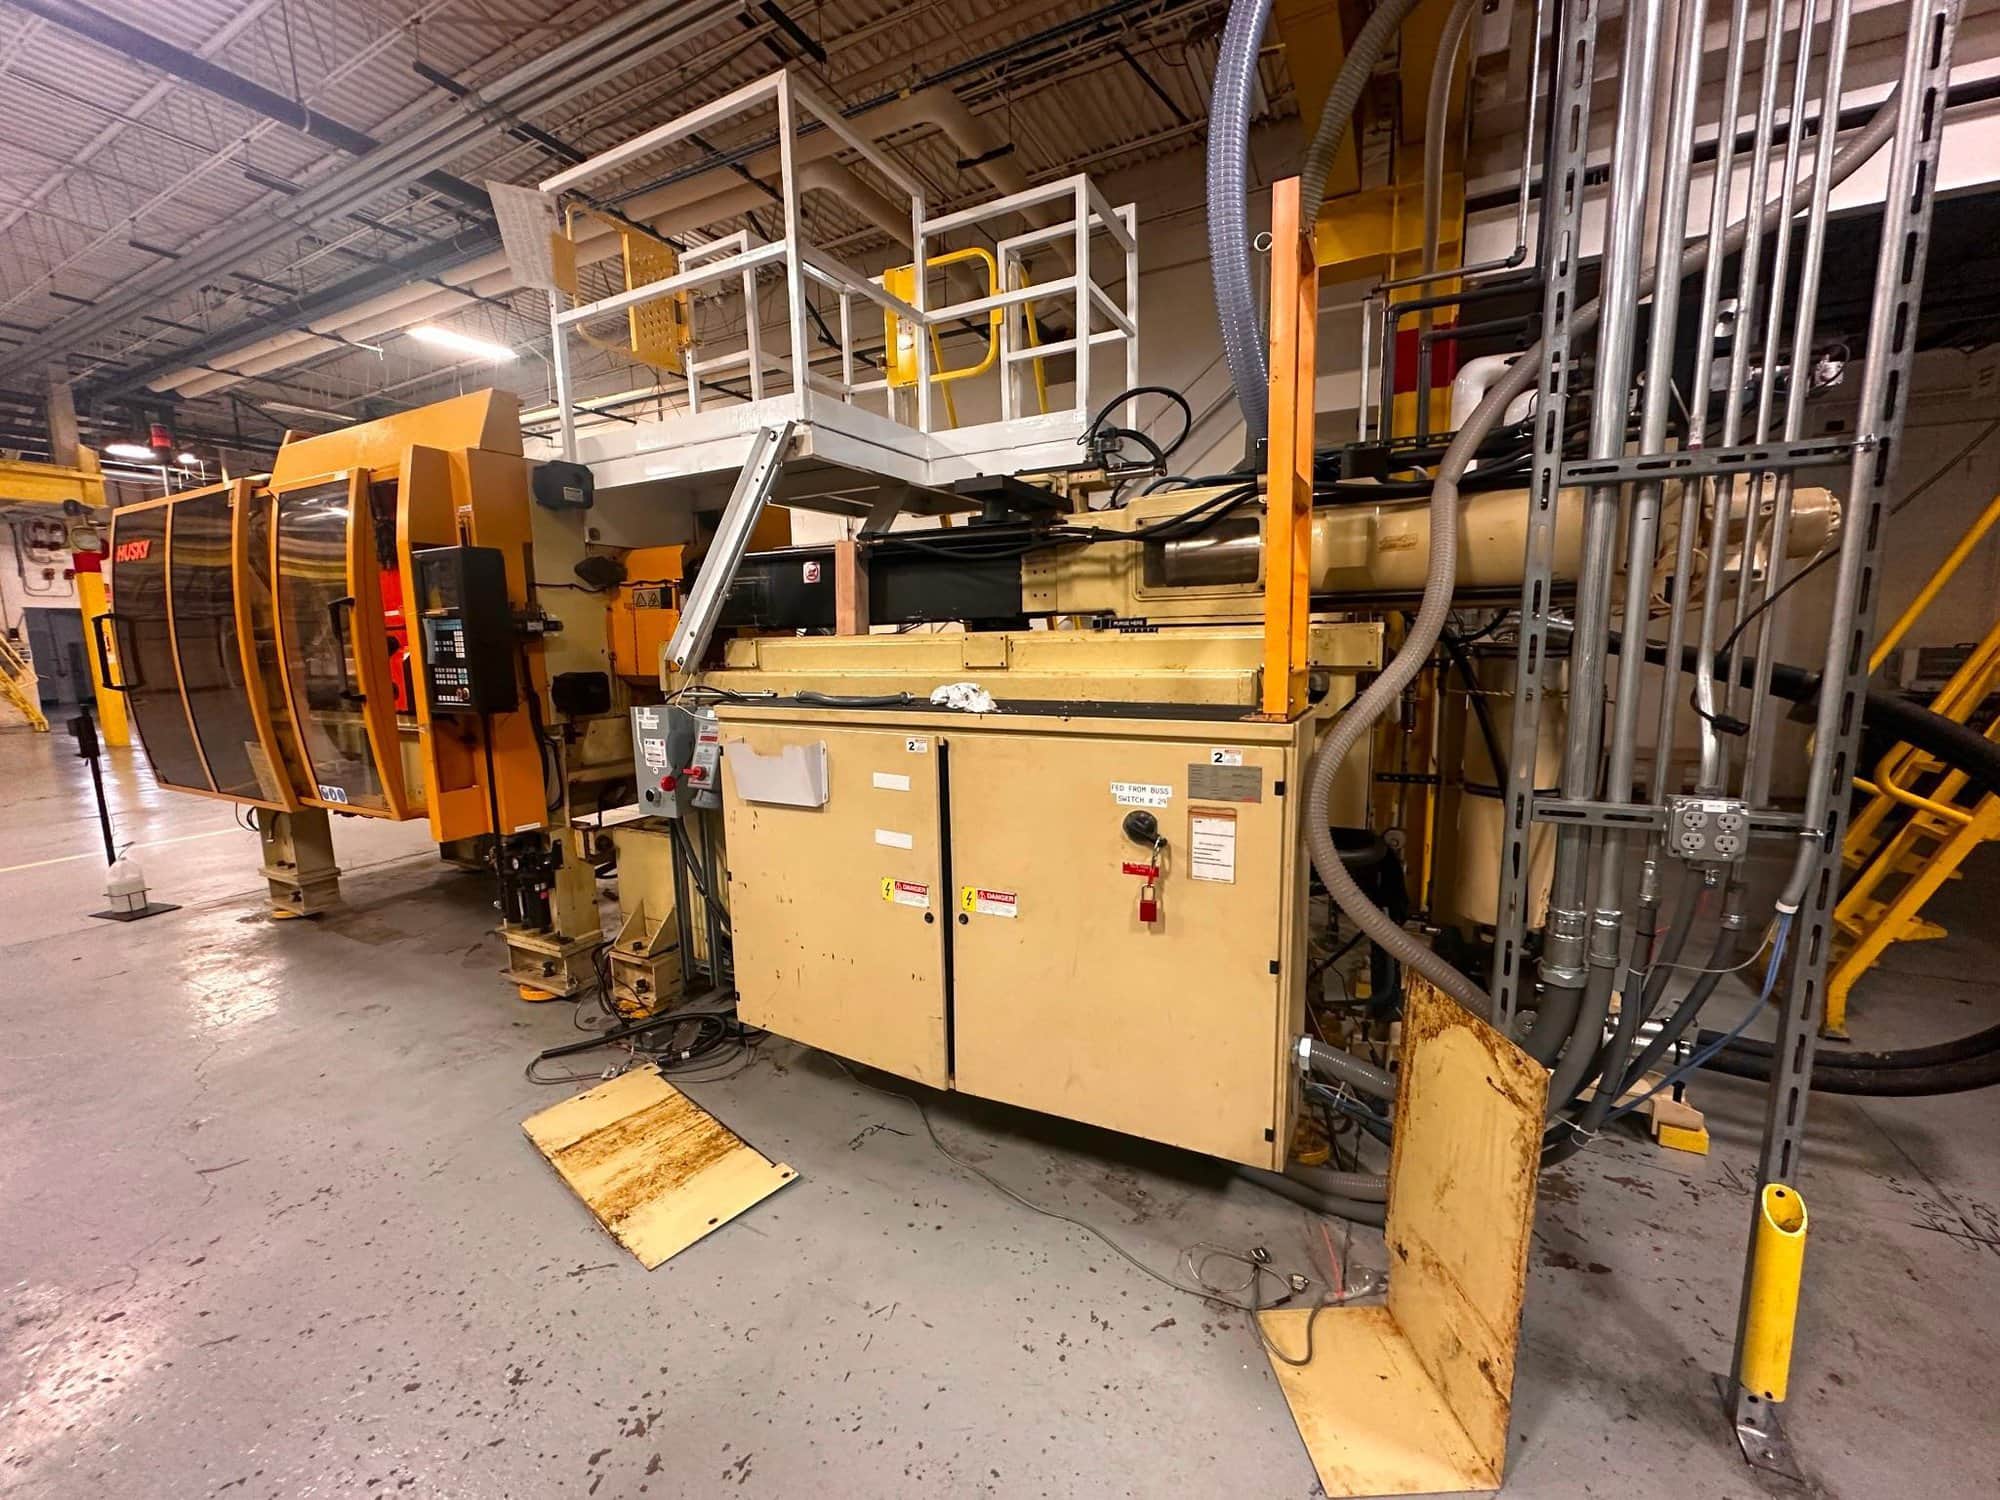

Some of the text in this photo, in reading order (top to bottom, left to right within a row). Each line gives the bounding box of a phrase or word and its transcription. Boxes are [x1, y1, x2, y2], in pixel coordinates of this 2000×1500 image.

[116, 540, 150, 562] HUSKY
[908, 741, 915, 751] 2
[1213, 752, 1223, 763] 2
[1128, 785, 1147, 793] FROM
[1150, 787, 1169, 795] BUSS
[1118, 795, 1145, 803] SWITCH
[902, 884, 926, 894] DANGER
[986, 892, 1014, 903] DANGER
